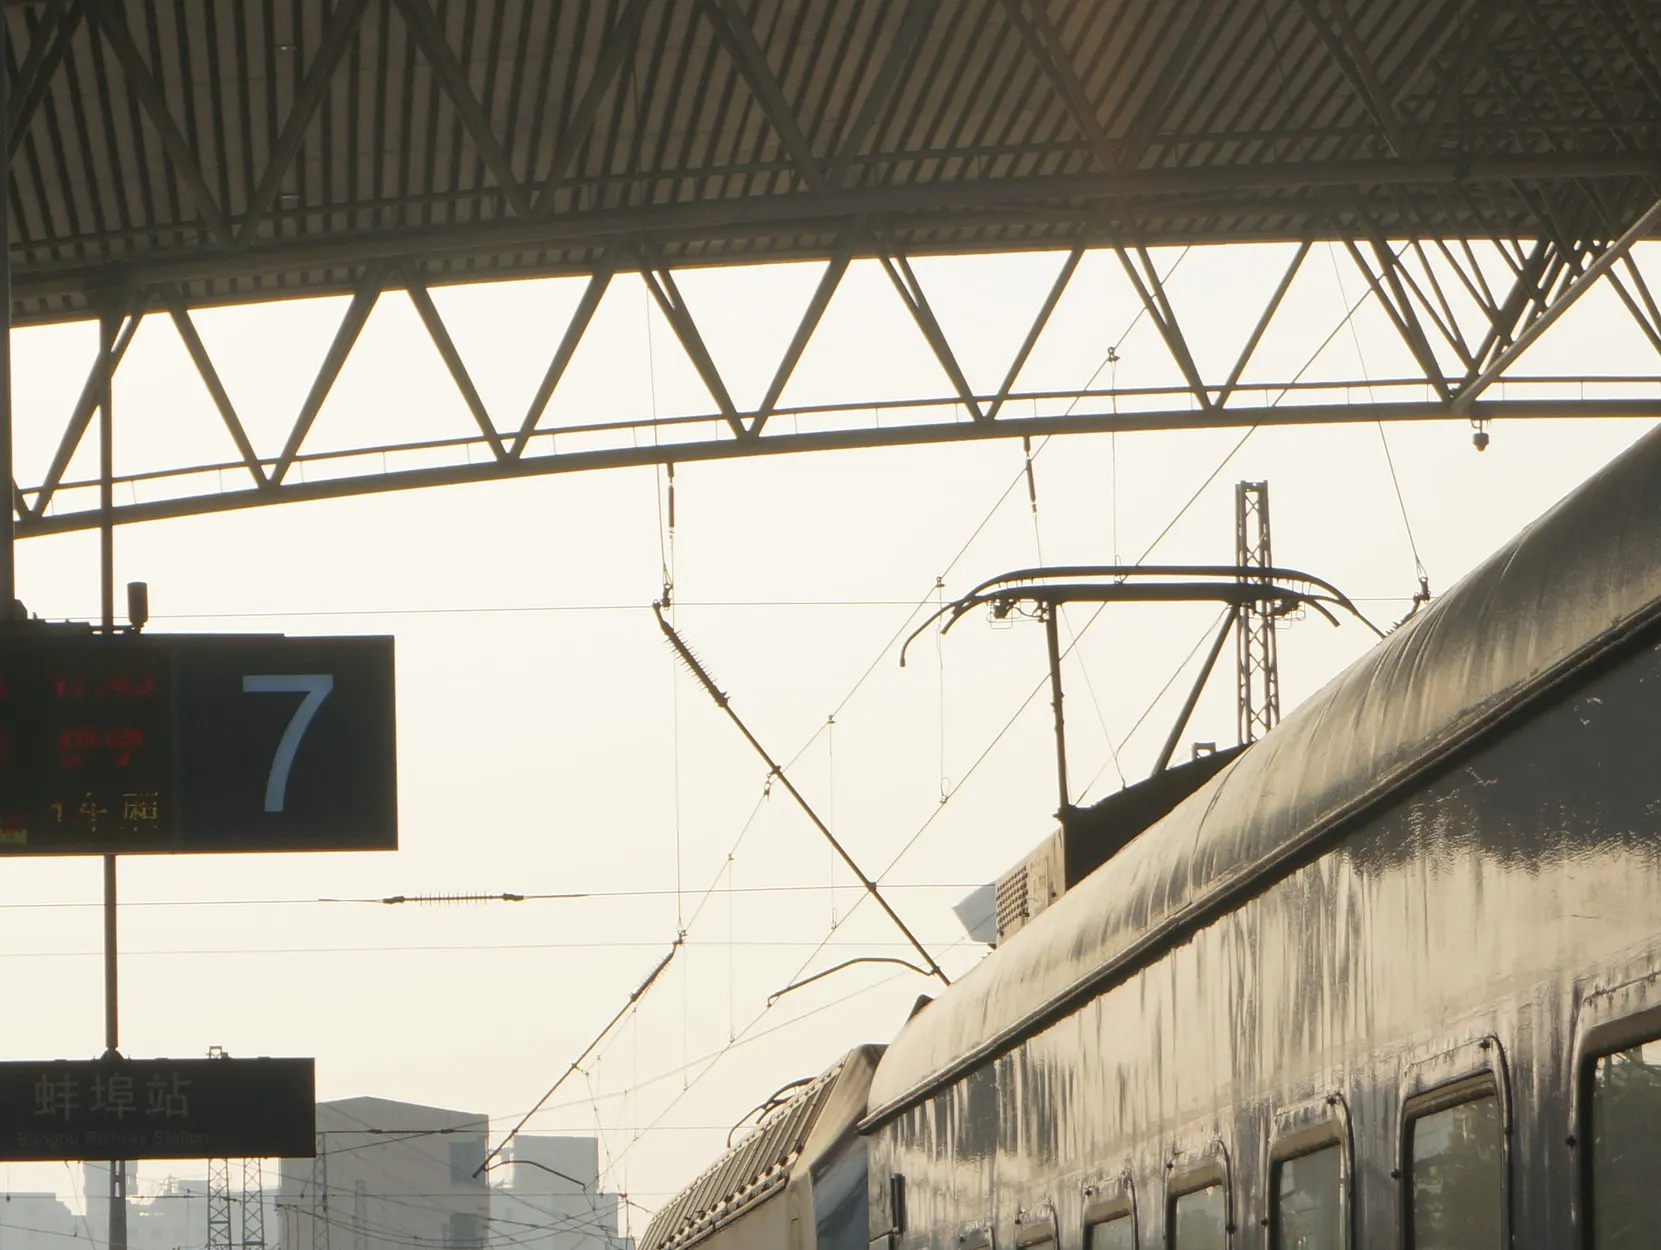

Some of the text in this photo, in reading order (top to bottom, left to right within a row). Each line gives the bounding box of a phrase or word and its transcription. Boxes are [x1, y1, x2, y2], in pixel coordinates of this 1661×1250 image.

[241, 673, 334, 813] 7
[34, 1070, 192, 1122] 蚌埠站
[85, 1130, 147, 1148] Railway
[153, 1129, 209, 1146] Station
